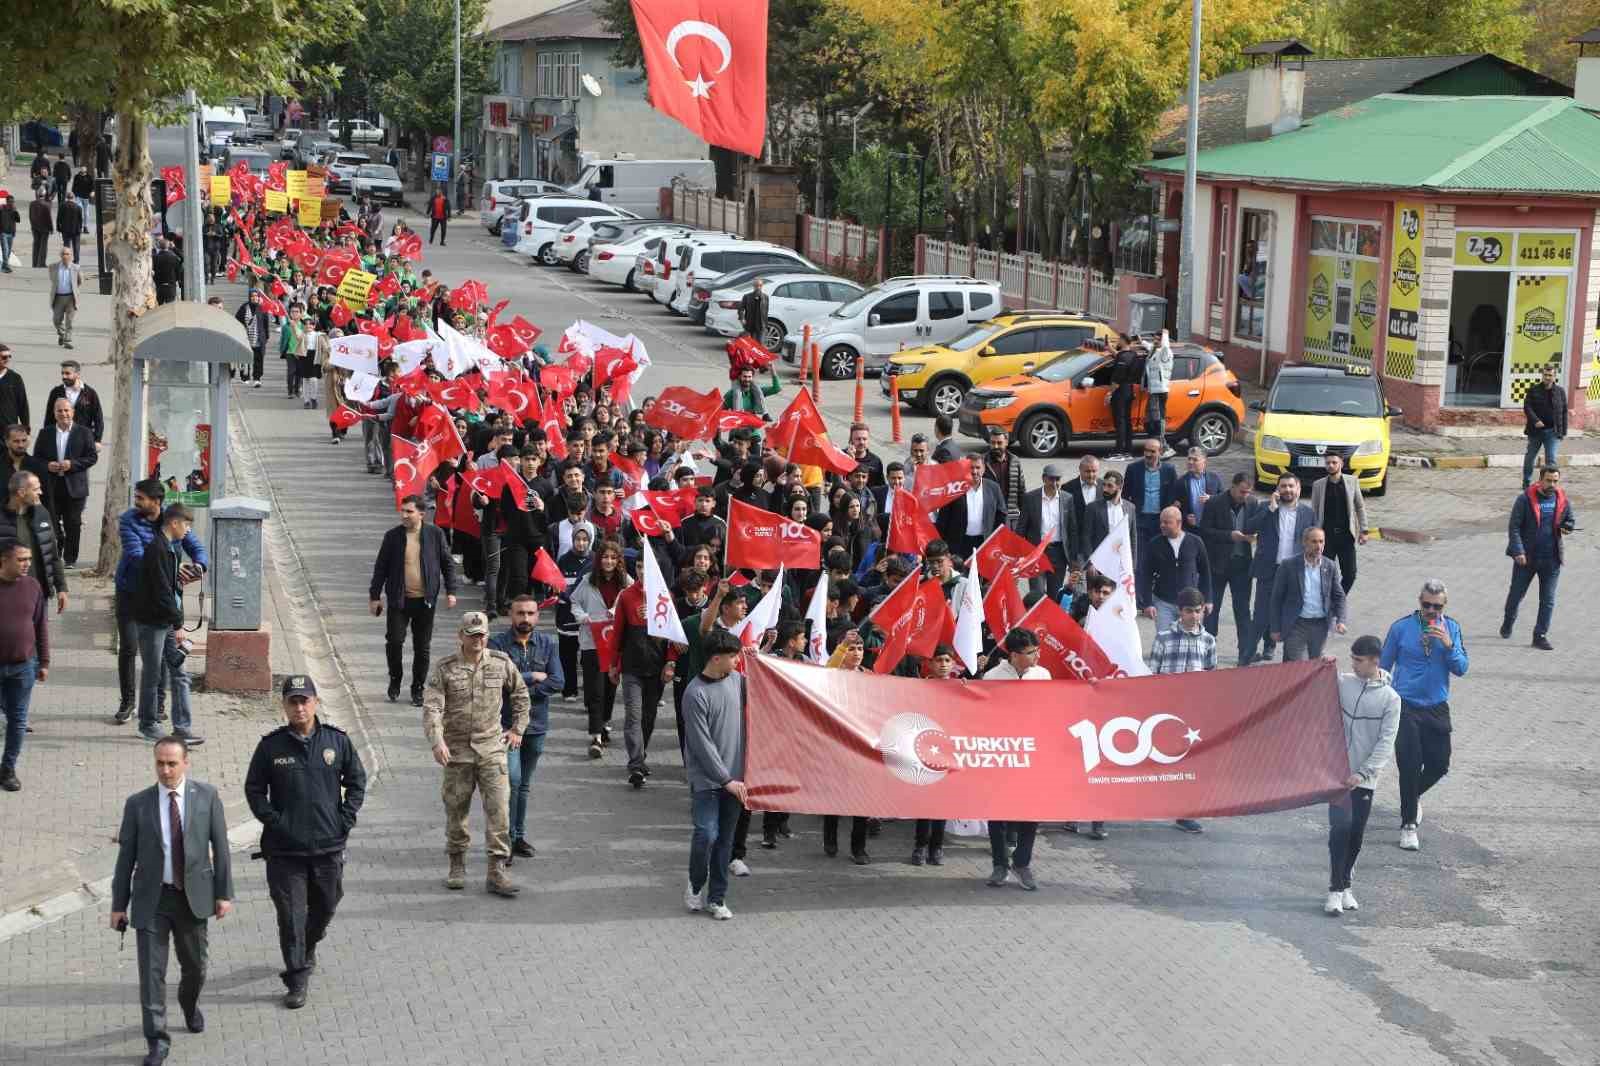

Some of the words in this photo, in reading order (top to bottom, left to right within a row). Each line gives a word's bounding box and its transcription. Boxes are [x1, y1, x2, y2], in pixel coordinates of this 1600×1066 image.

[1520, 247, 1540, 260] 411
[1542, 247, 1556, 260] 46
[1558, 247, 1572, 260] 46
[1346, 364, 1370, 374] TAXI
[1067, 713, 1196, 774] 100
